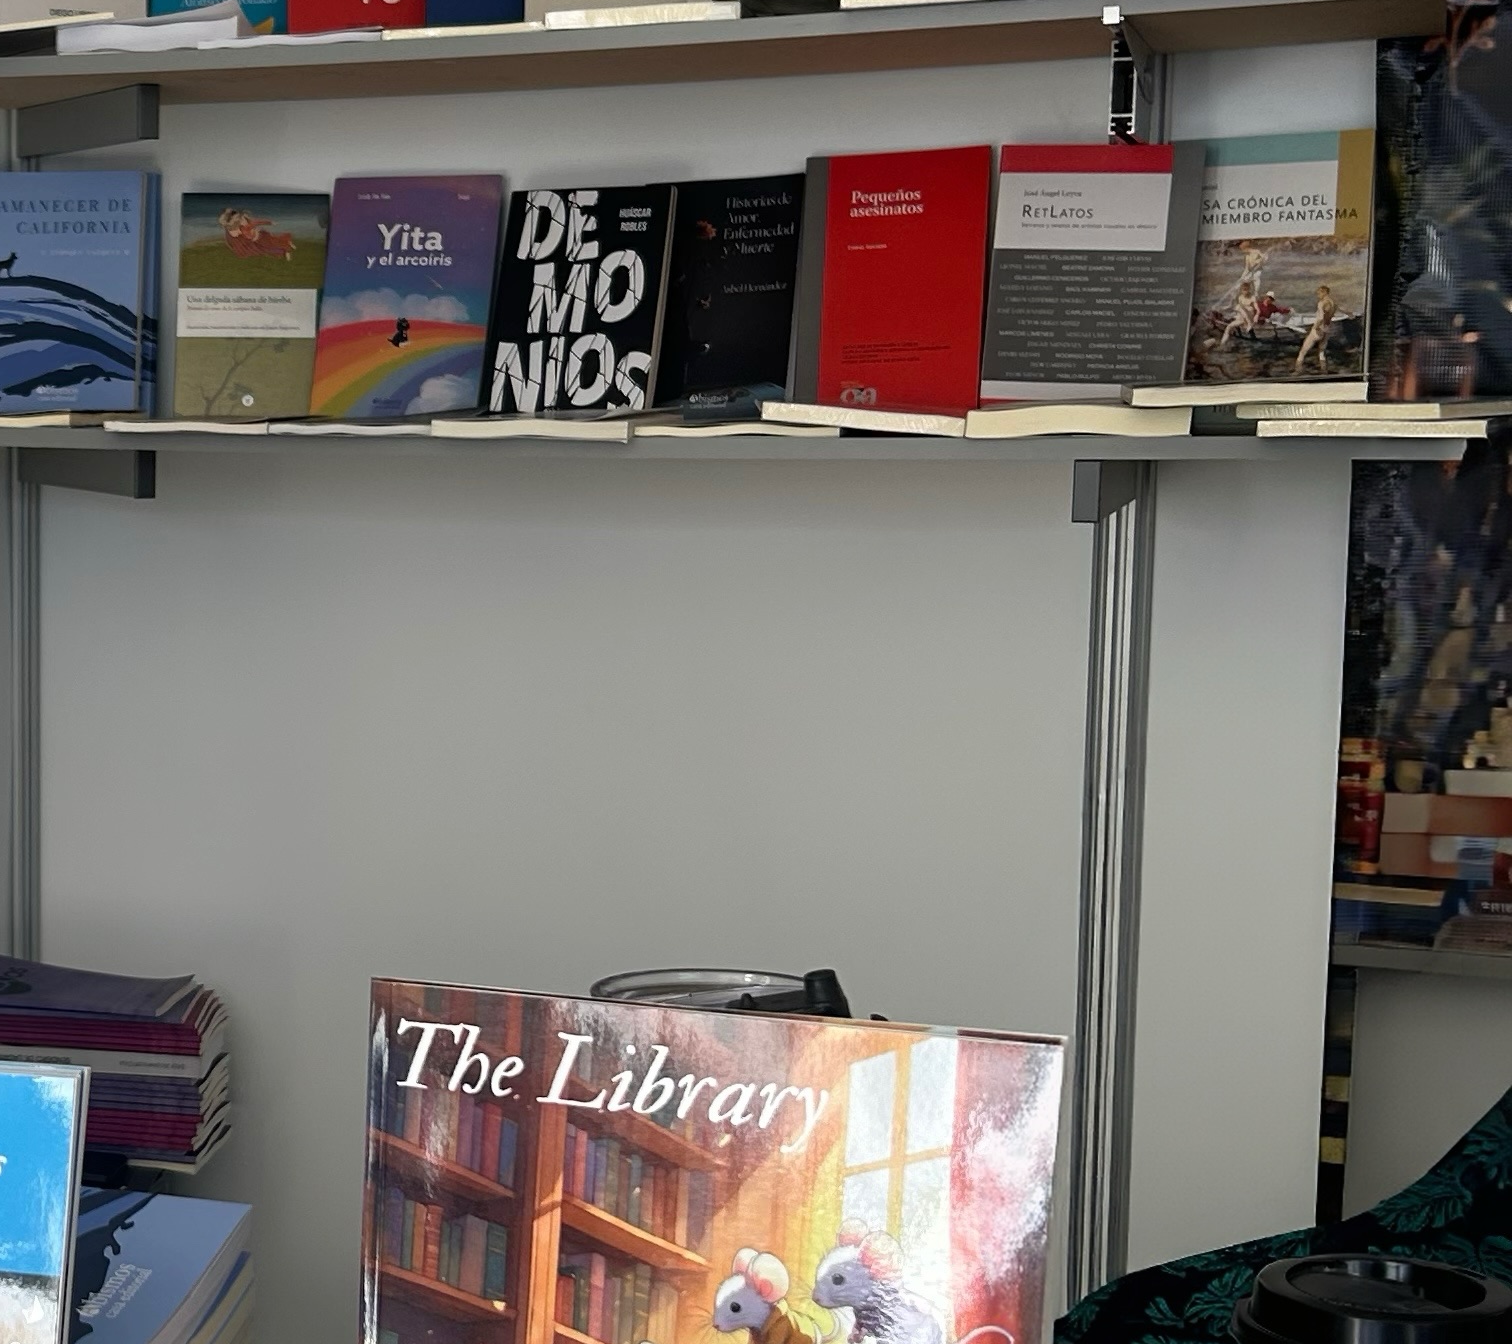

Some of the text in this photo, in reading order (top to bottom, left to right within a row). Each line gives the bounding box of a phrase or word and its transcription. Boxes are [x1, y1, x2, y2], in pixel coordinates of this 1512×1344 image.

[108, 198, 131, 212] DE
[726, 192, 793, 209] Historias de
[851, 188, 922, 206] Pequeños
[1227, 194, 1293, 210] CRÓNICA
[1301, 193, 1328, 207] DEL
[849, 202, 924, 219] asesinatos
[1202, 207, 1358, 225] MIEMBRO FANTASMA
[16, 220, 131, 234] CALIFORNIA
[517, 190, 600, 261] DE
[620, 221, 648, 232] ROBLES
[723, 221, 794, 240] Enfermedad
[377, 223, 444, 251] Yita
[367, 252, 393, 269] y el
[527, 249, 646, 335] MO
[489, 331, 652, 413] NIOS
[396, 1017, 831, 1154] The Library
